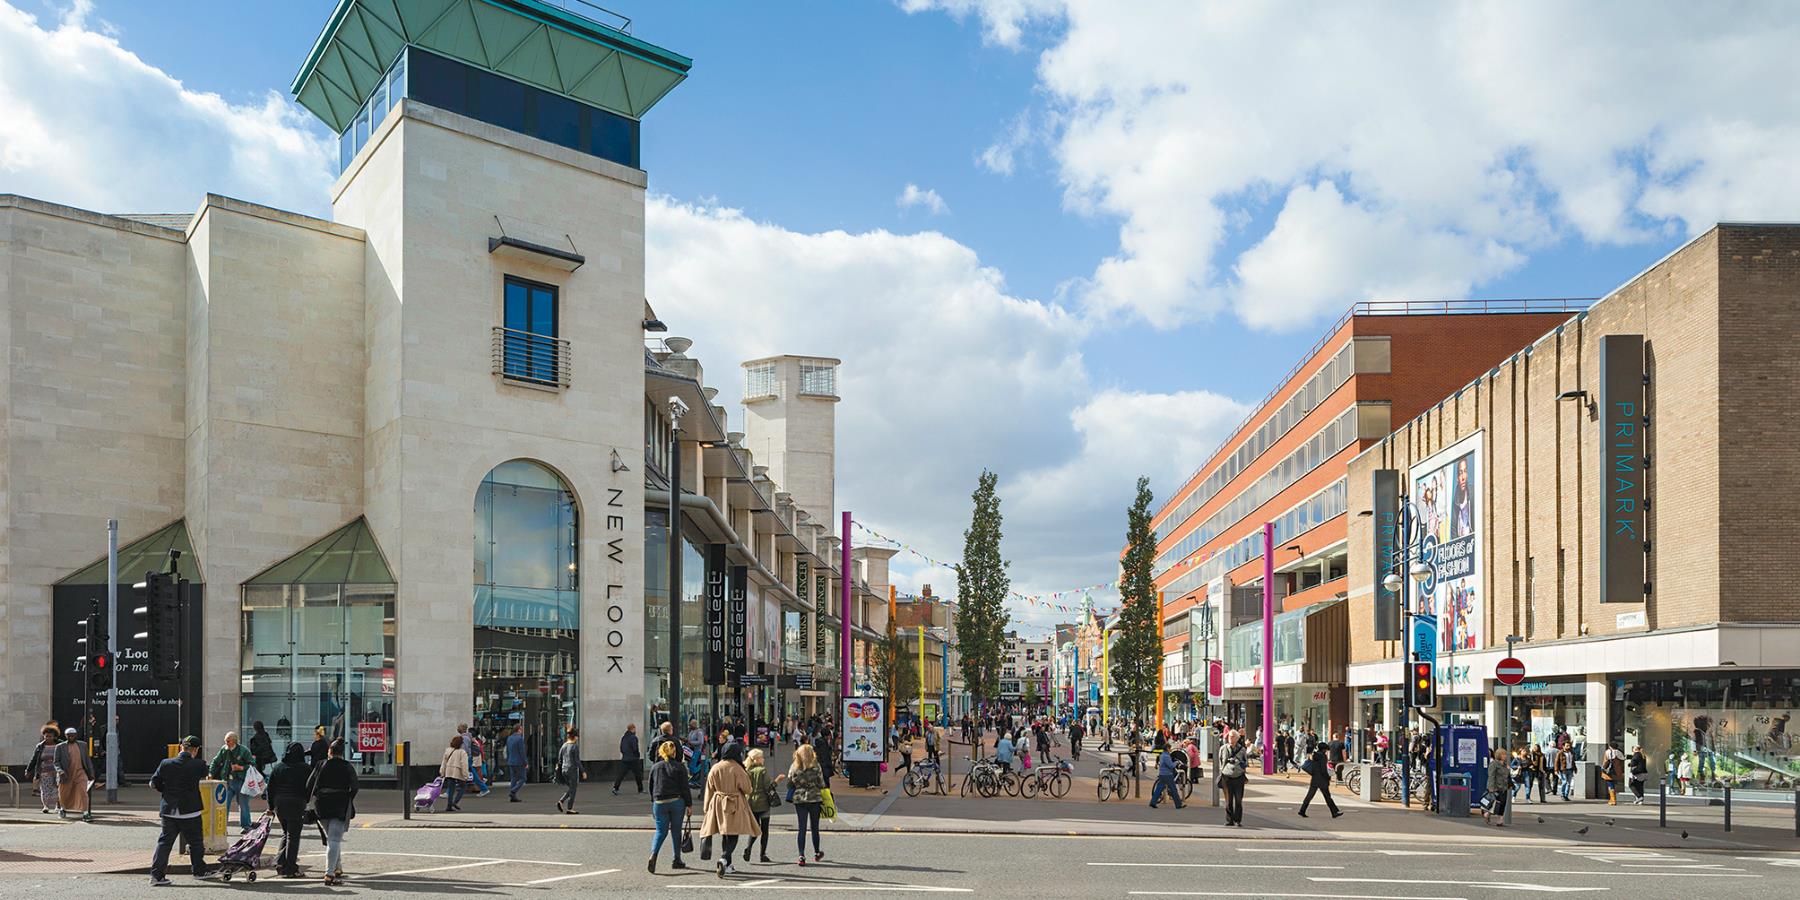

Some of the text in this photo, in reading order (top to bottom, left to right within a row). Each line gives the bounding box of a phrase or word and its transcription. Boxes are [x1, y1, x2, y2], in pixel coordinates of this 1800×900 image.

[1615, 402, 1635, 536] PRIMARK
[1382, 511, 1394, 597] PRIMAK
[1422, 533, 1438, 598] 3
[1438, 541, 1466, 563] FLOORS
[1438, 556, 1469, 580] FASHION
[607, 488, 623, 673] NEW LOOK
[798, 562, 808, 600] PENCER
[817, 576, 825, 614] SPENCER
[712, 570, 723, 652] select
[735, 589, 744, 659] select
[125, 648, 148, 659] Loo
[817, 623, 825, 654] MARKS
